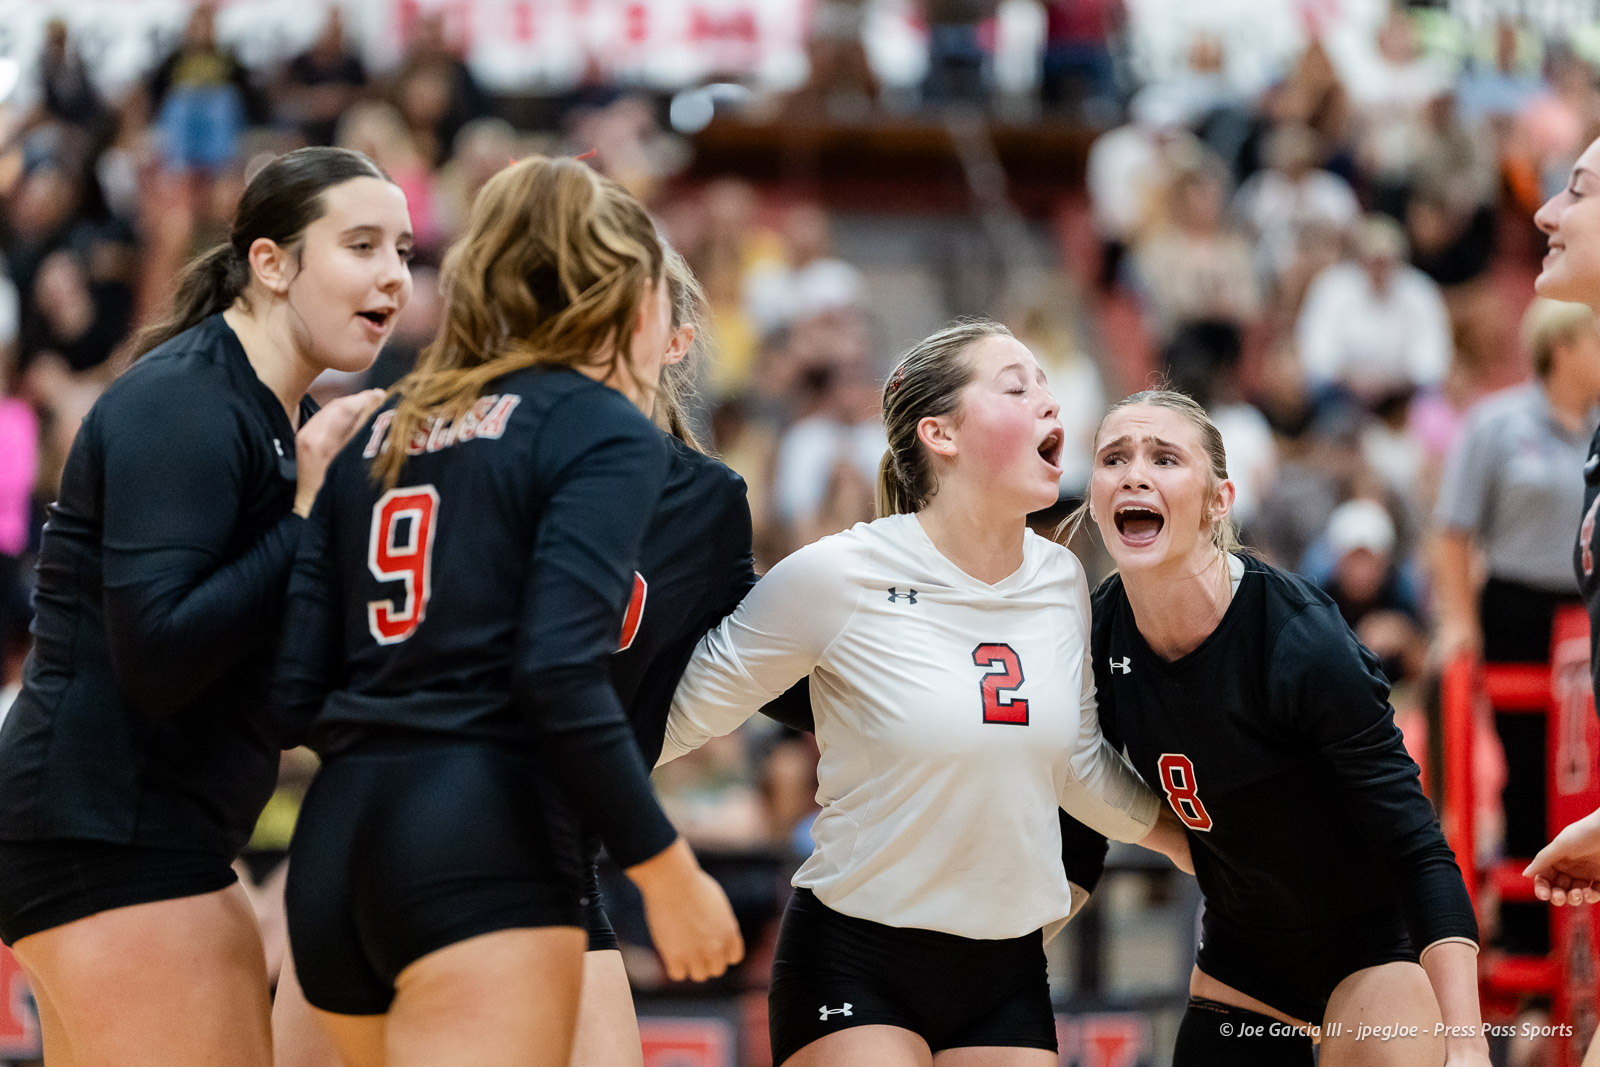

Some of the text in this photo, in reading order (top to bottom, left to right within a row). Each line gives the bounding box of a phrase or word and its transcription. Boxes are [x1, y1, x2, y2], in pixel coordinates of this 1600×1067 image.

[367, 483, 441, 646] 9
[971, 642, 1030, 727] 2
[1157, 753, 1213, 833] 8
